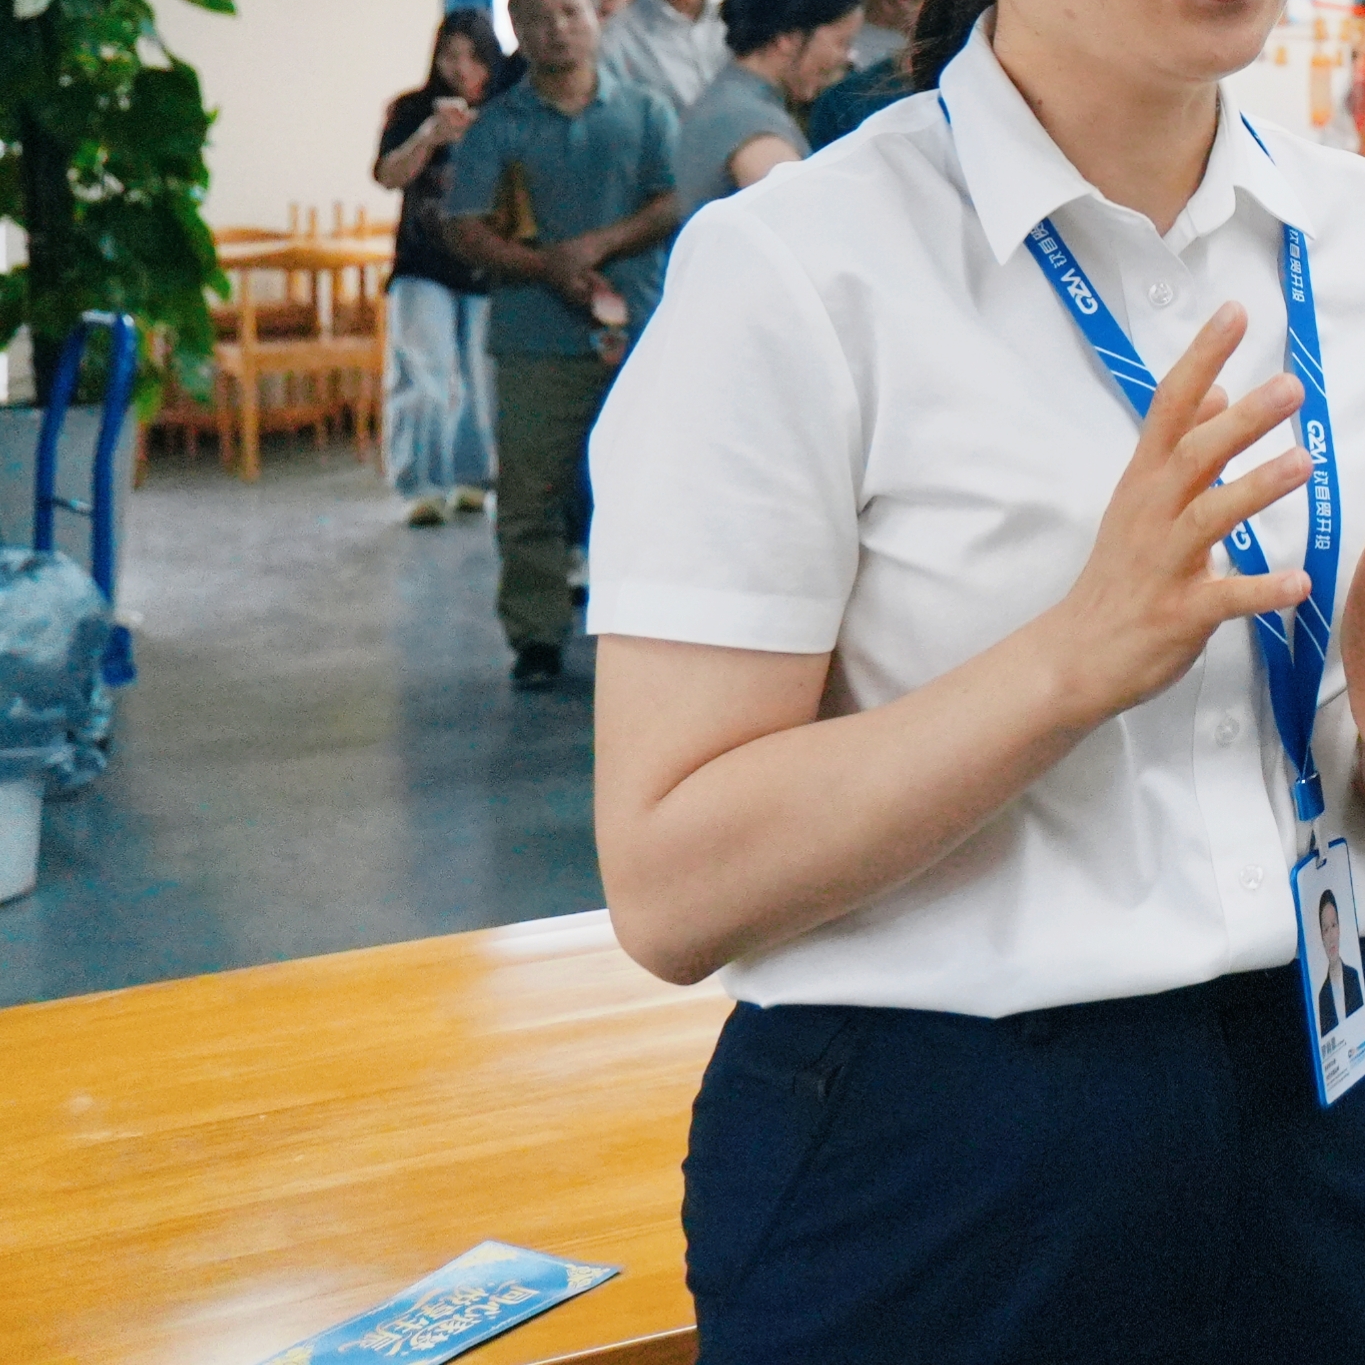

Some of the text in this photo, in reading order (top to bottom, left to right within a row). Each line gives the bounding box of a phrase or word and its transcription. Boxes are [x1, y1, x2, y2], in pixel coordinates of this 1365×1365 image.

[1060, 268, 1099, 315] QZM
[1313, 470, 1332, 551] 钦自贸开投
